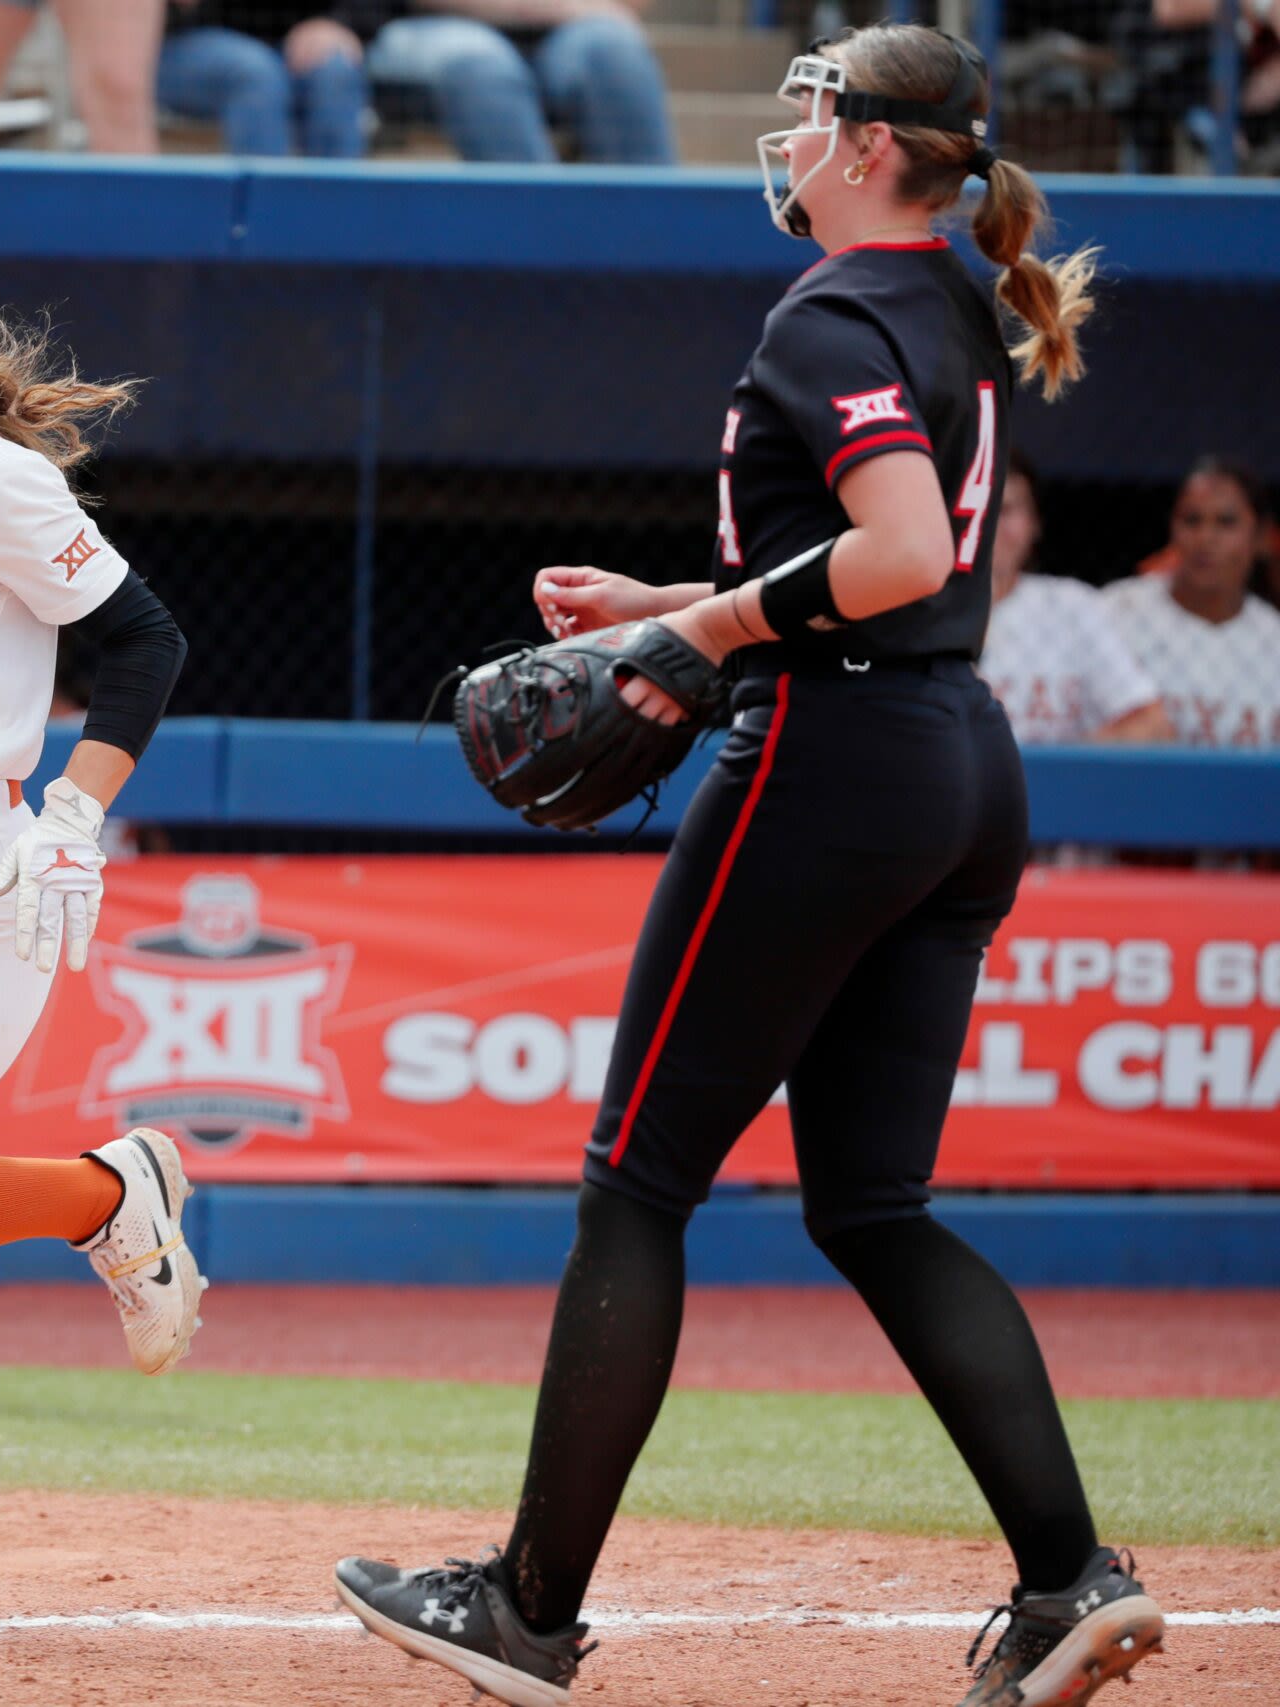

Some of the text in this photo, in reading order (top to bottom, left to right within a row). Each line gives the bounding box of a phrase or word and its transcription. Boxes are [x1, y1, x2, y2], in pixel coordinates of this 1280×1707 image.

[832, 384, 912, 435] XII
[51, 527, 102, 582] XII
[106, 964, 327, 1098] XII
